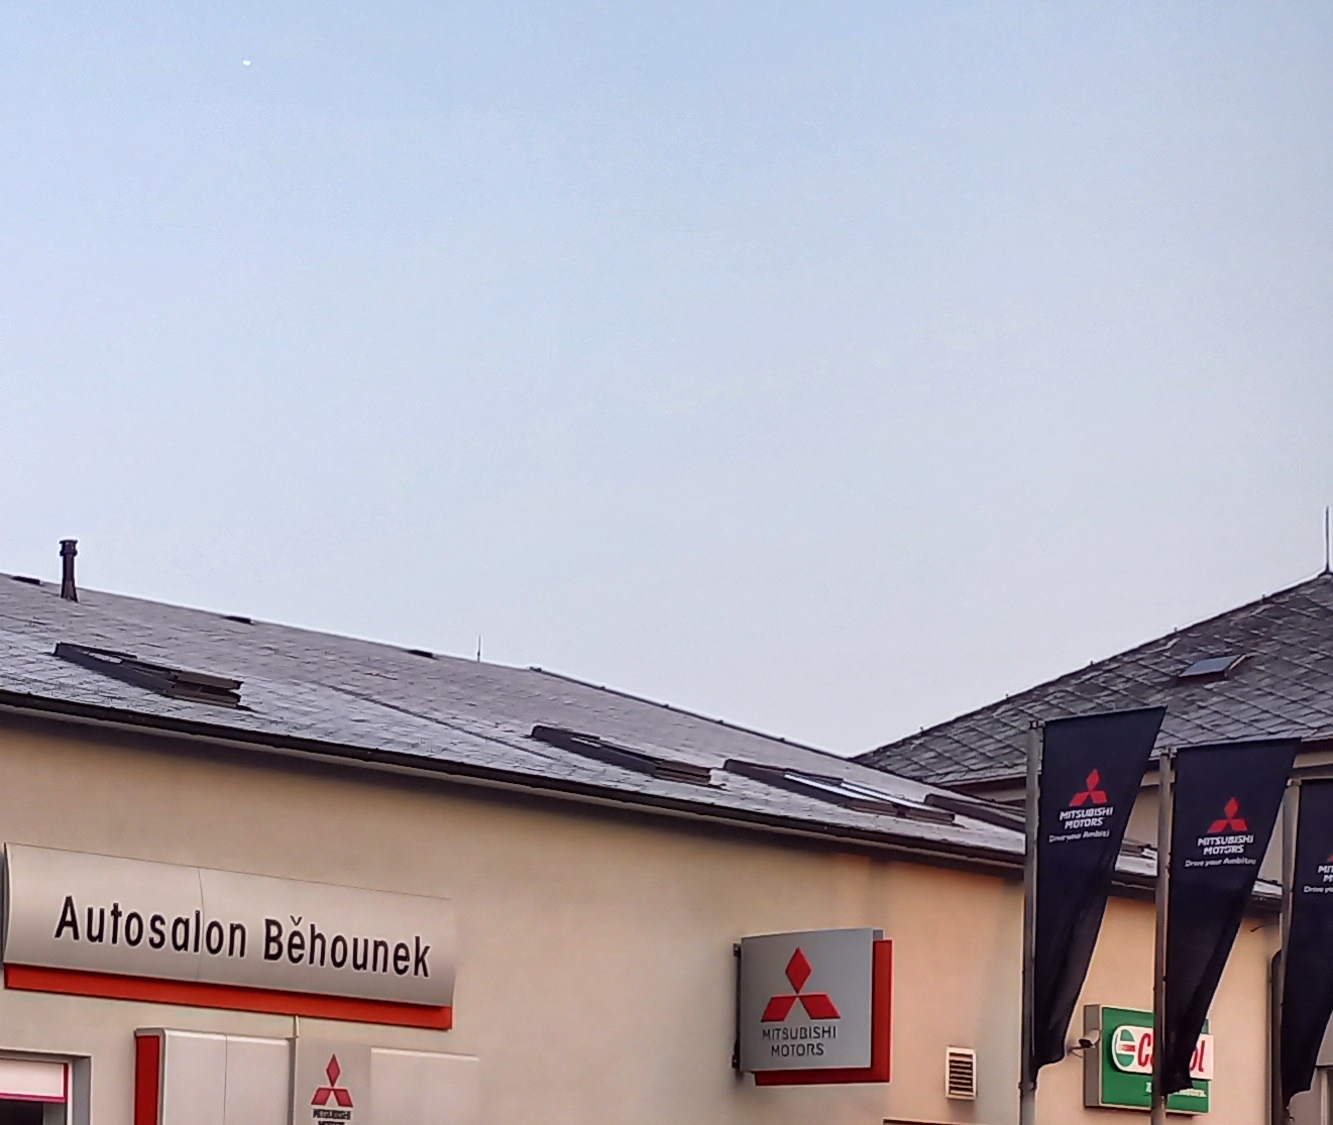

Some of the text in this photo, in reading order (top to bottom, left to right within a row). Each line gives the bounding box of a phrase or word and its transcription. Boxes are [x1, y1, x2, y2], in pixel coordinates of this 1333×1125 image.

[54, 895, 431, 979] Autosalon Běhounek
[762, 1025, 837, 1041] MITSUBISHI
[771, 1042, 825, 1057] MOTORS
